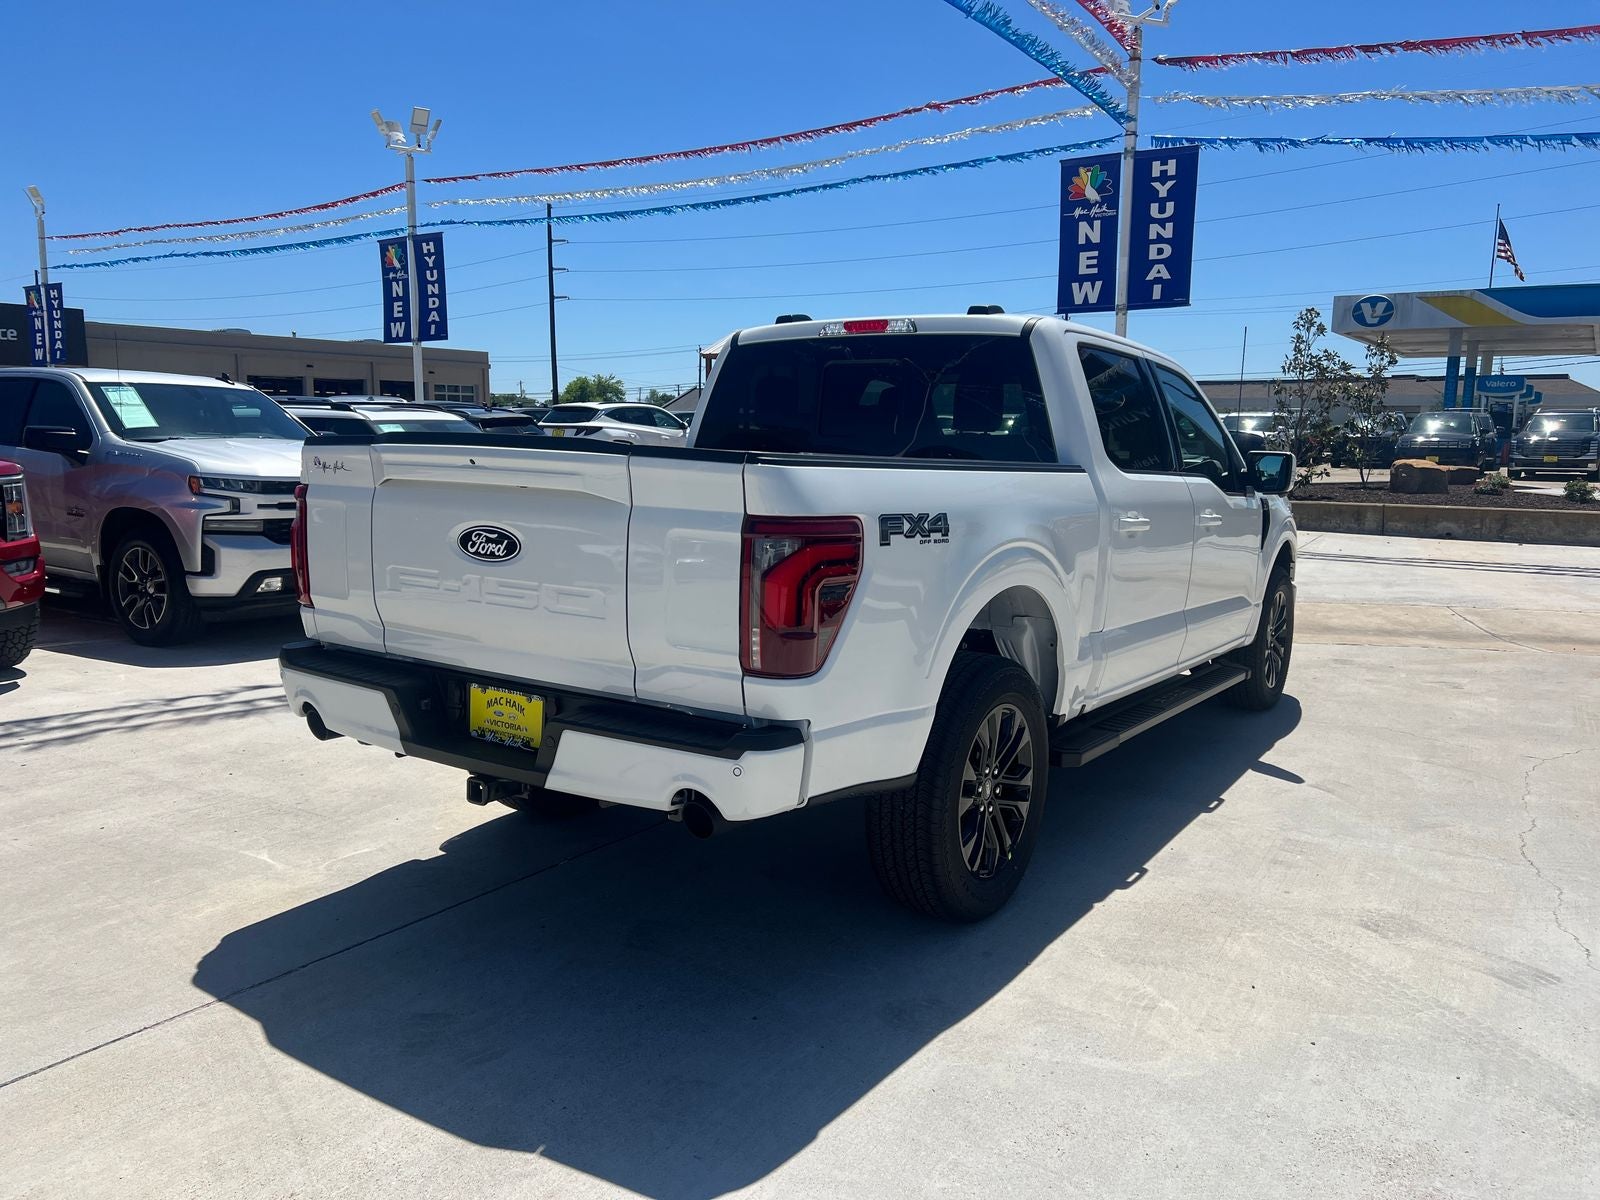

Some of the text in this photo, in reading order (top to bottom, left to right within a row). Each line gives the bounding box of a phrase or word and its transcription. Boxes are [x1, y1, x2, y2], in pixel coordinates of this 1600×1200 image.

[1144, 159, 1177, 300] HYUNDAI
[1071, 220, 1103, 305] NEW
[390, 280, 405, 338] NEW
[422, 241, 440, 335] HYUNDAI
[34, 317, 44, 361] NEW
[50, 289, 63, 359] HYUNDAI
[1485, 379, 1517, 388] Valero
[467, 530, 507, 557] Ford
[878, 512, 950, 547] FX4
[386, 565, 607, 620] F-150
[486, 696, 525, 717] MAC HAIK
[489, 719, 522, 732] VICTORIA
